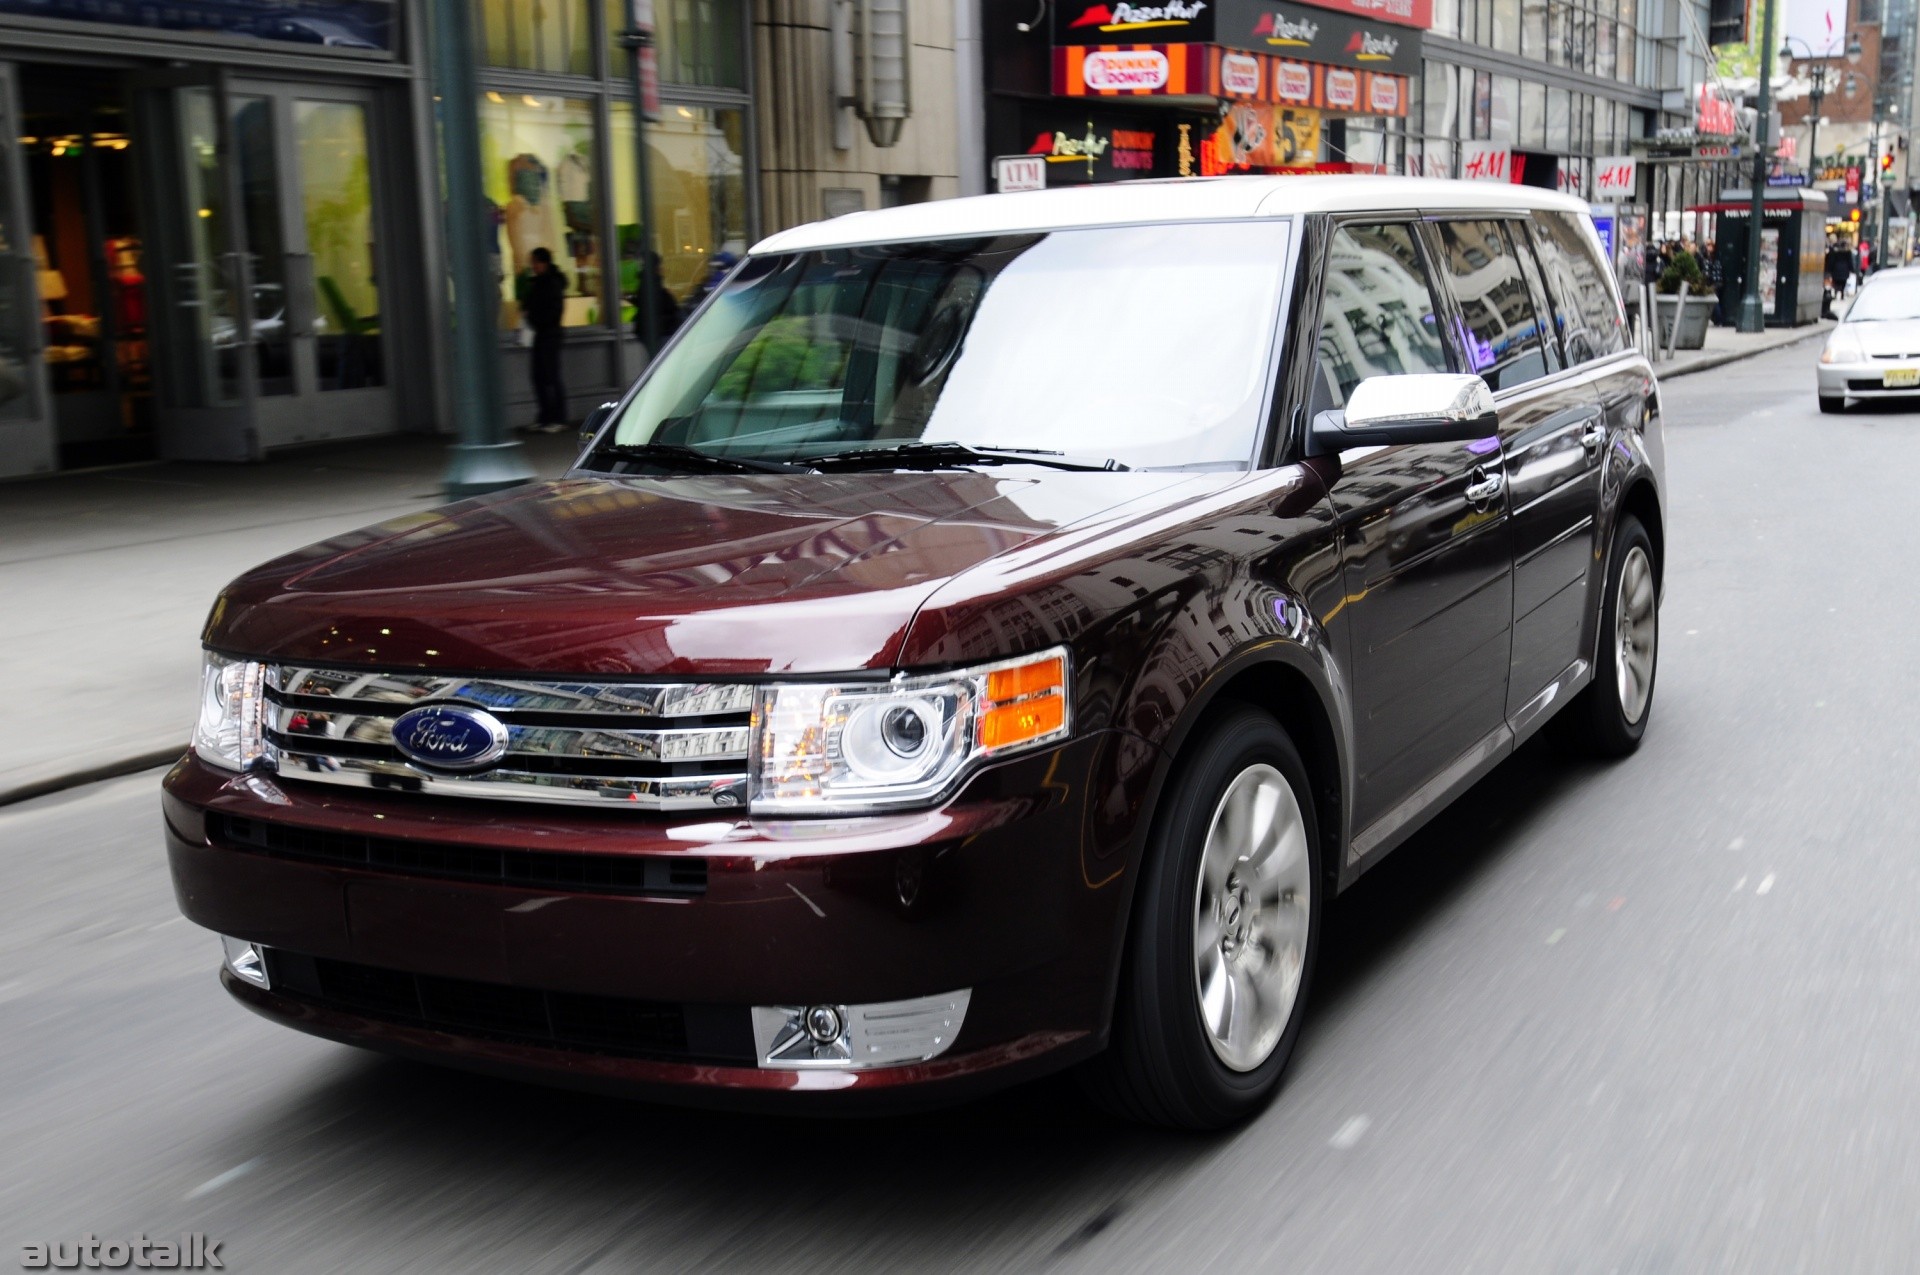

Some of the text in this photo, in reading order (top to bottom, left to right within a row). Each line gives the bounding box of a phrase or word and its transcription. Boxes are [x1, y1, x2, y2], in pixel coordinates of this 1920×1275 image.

[1106, 71, 1160, 83] DONUTS
[1006, 163, 1039, 183] ATM
[409, 716, 471, 753] Ford
